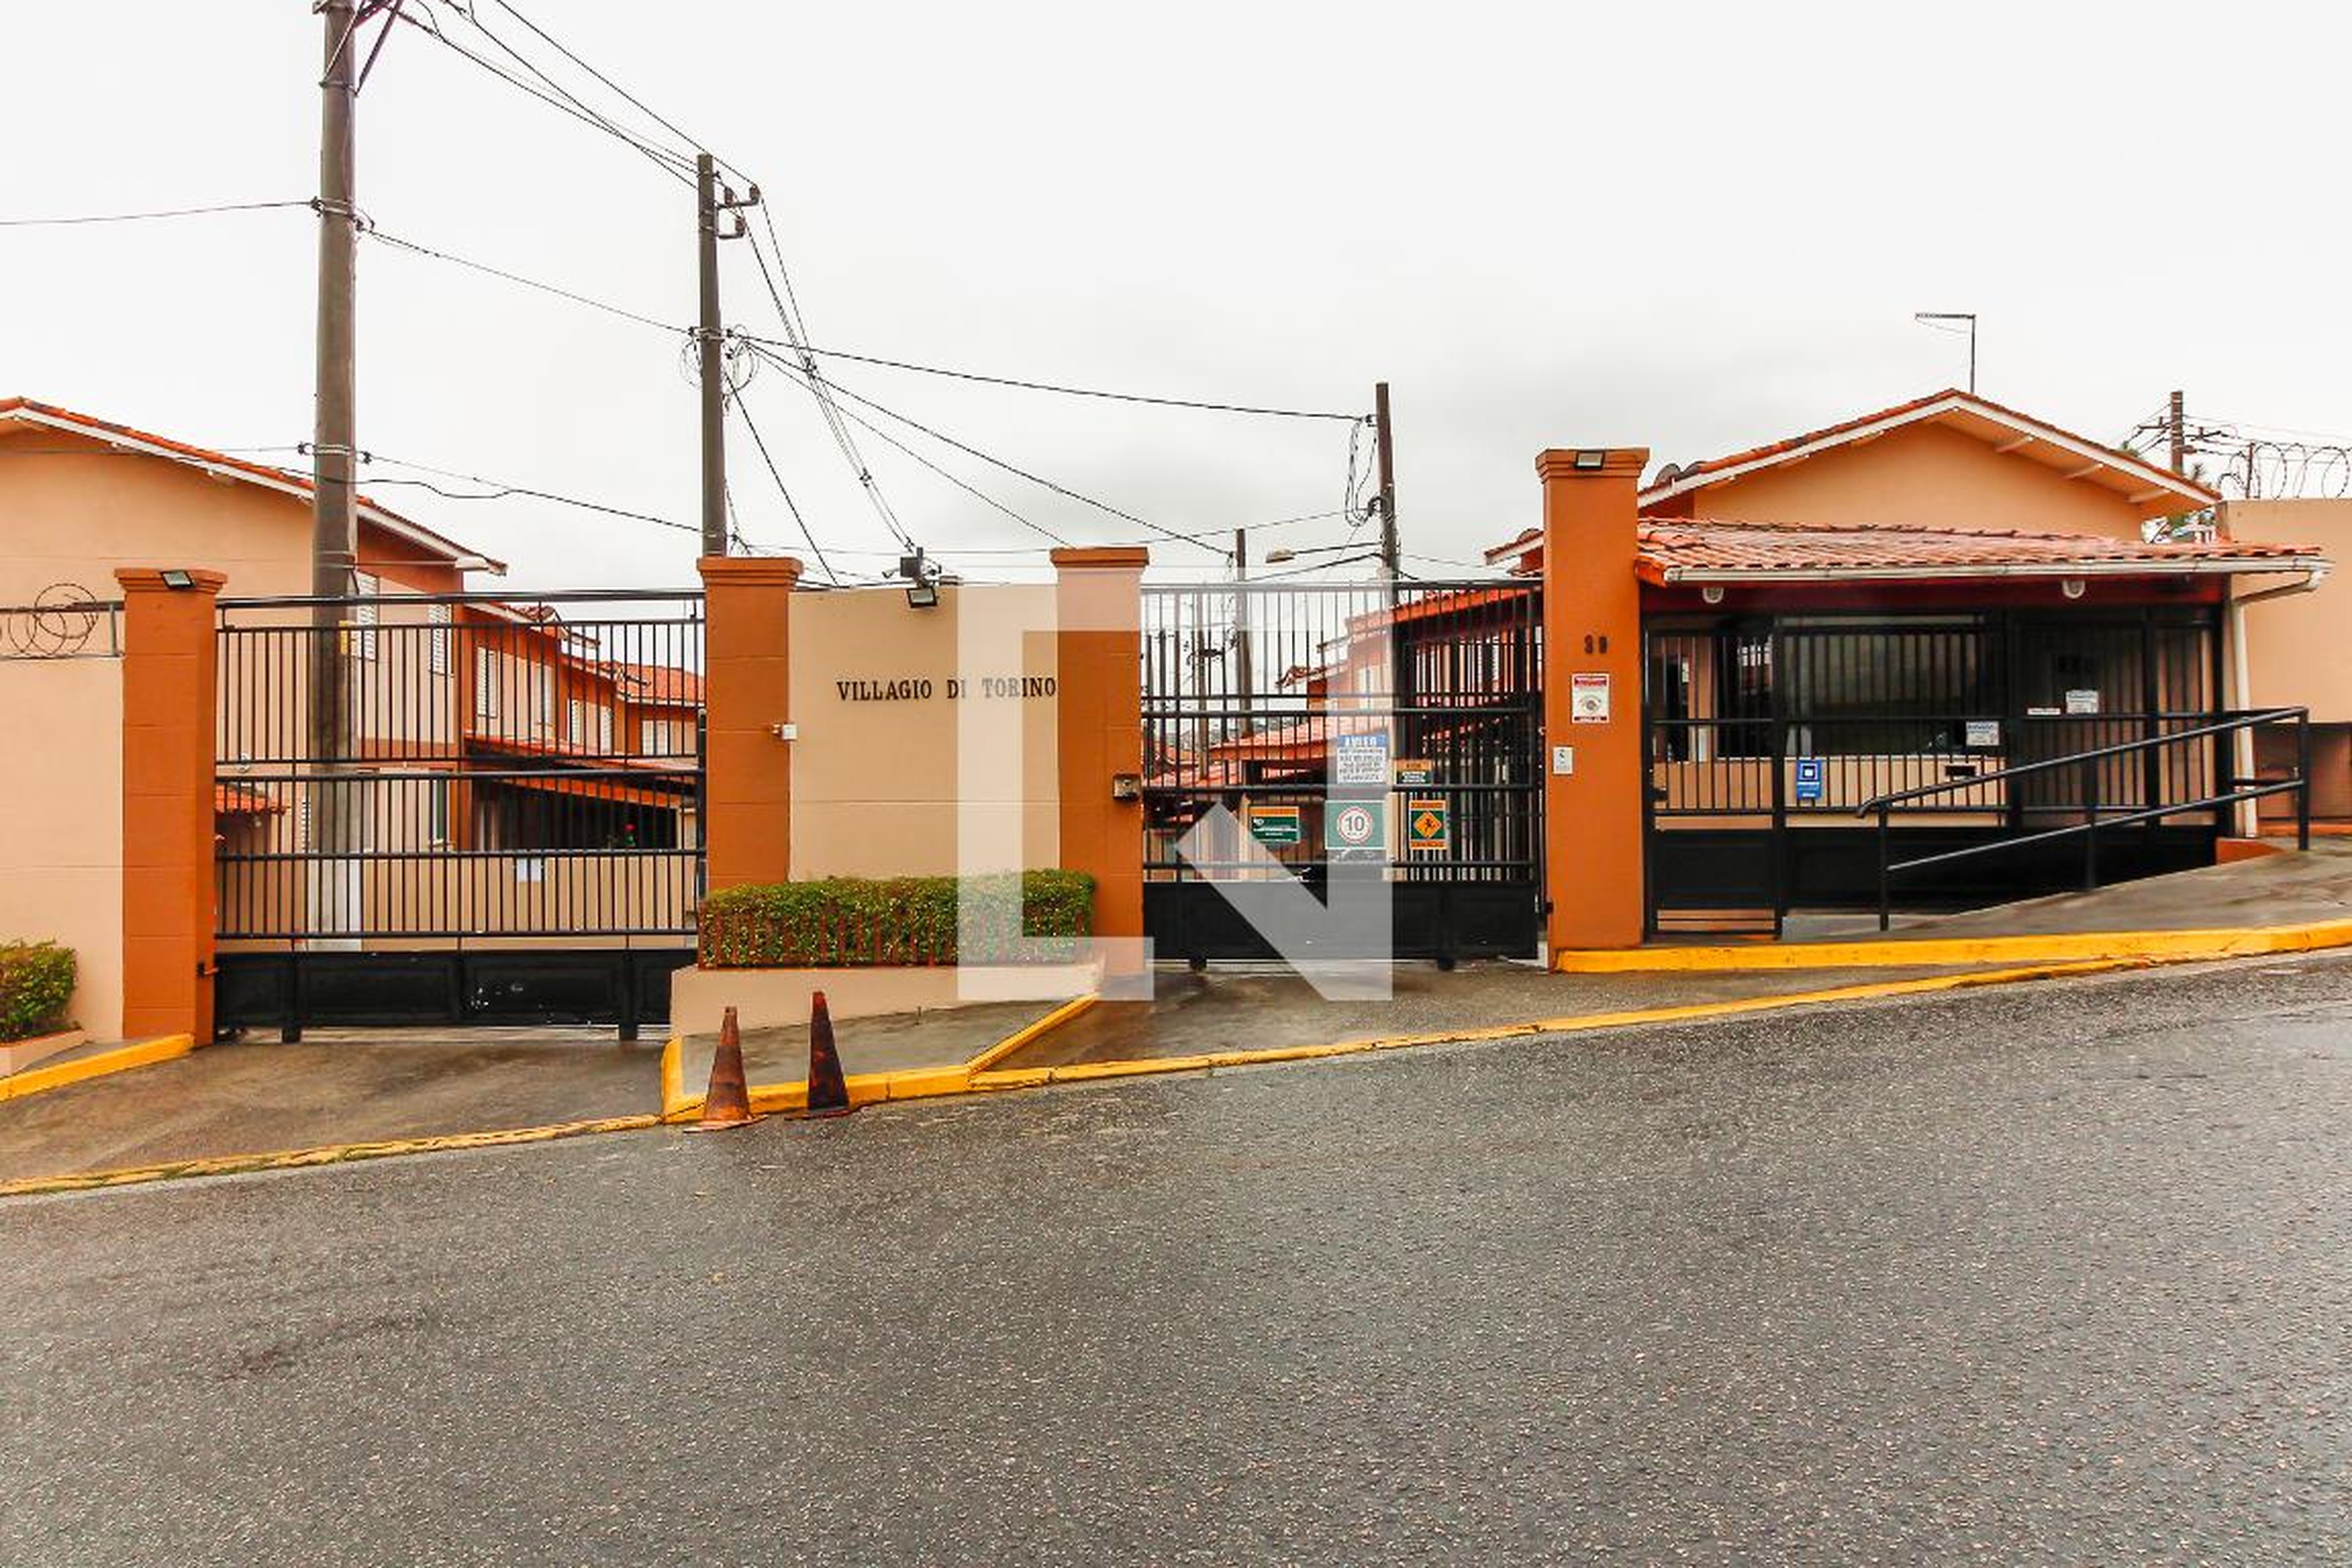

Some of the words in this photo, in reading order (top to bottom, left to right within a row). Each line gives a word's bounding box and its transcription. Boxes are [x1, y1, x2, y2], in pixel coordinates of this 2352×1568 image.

[837, 679, 932, 700] VILLAGIO
[947, 679, 966, 699] DI
[981, 677, 1056, 698] TORINO
[1344, 815, 1365, 831] 10
